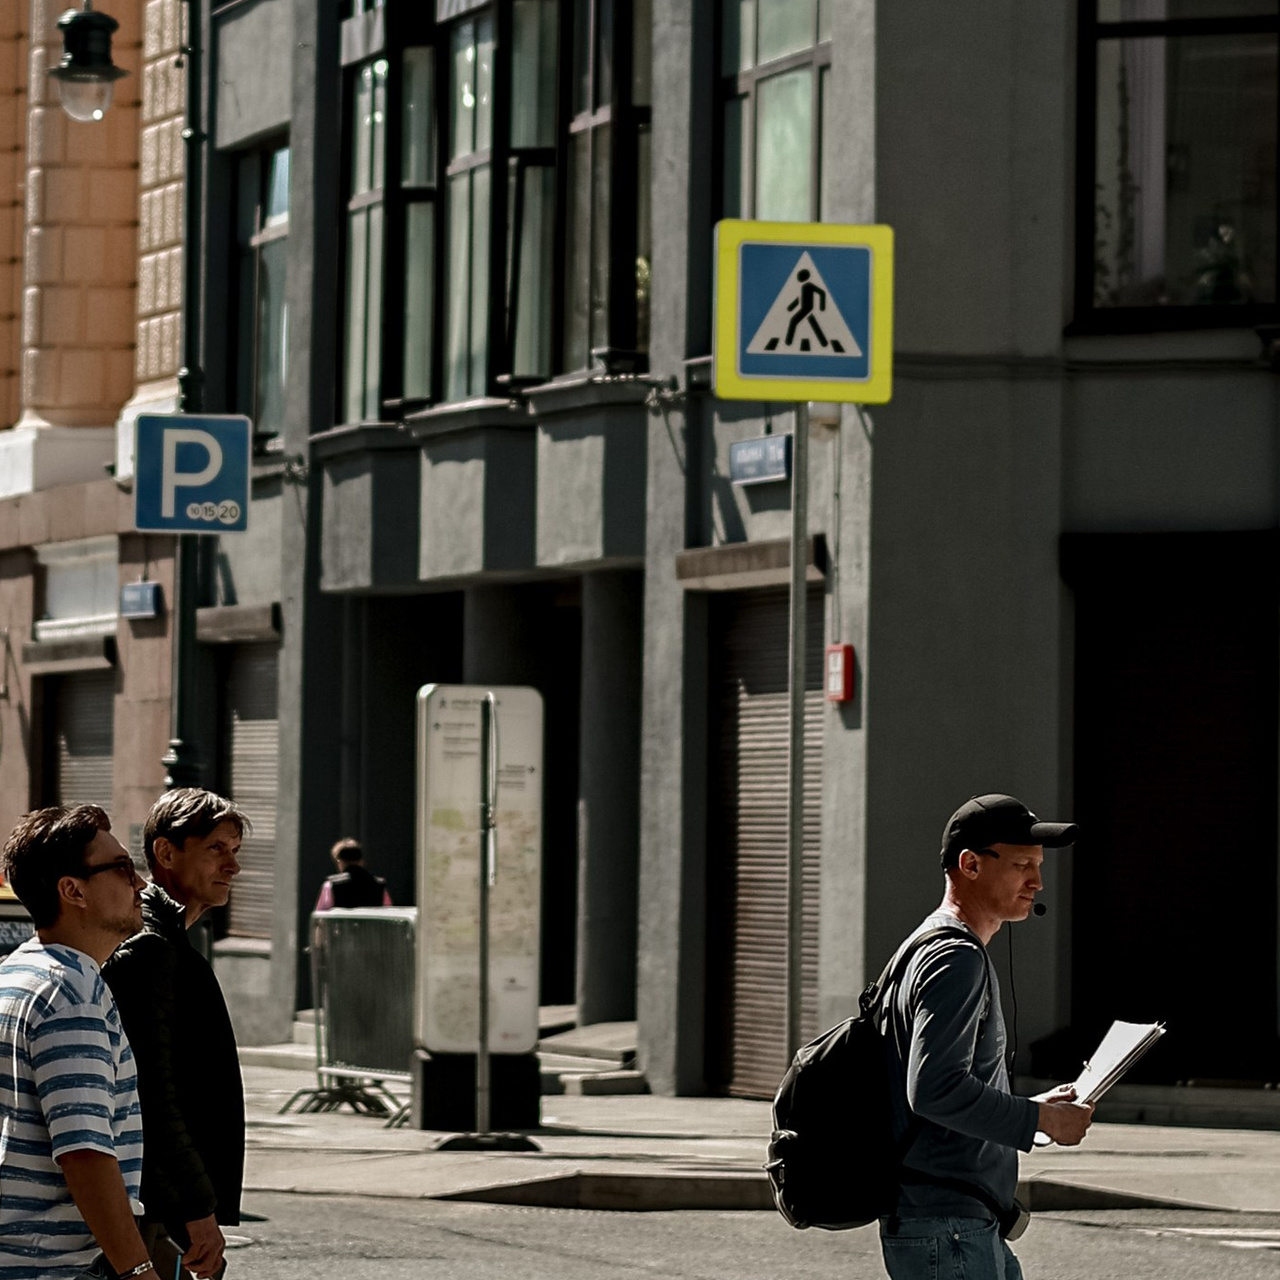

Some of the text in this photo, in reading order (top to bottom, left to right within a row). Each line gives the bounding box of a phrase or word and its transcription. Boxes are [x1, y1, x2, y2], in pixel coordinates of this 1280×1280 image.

[162, 428, 223, 518] P
[204, 506, 215, 517] 15
[220, 506, 238, 519] 20
